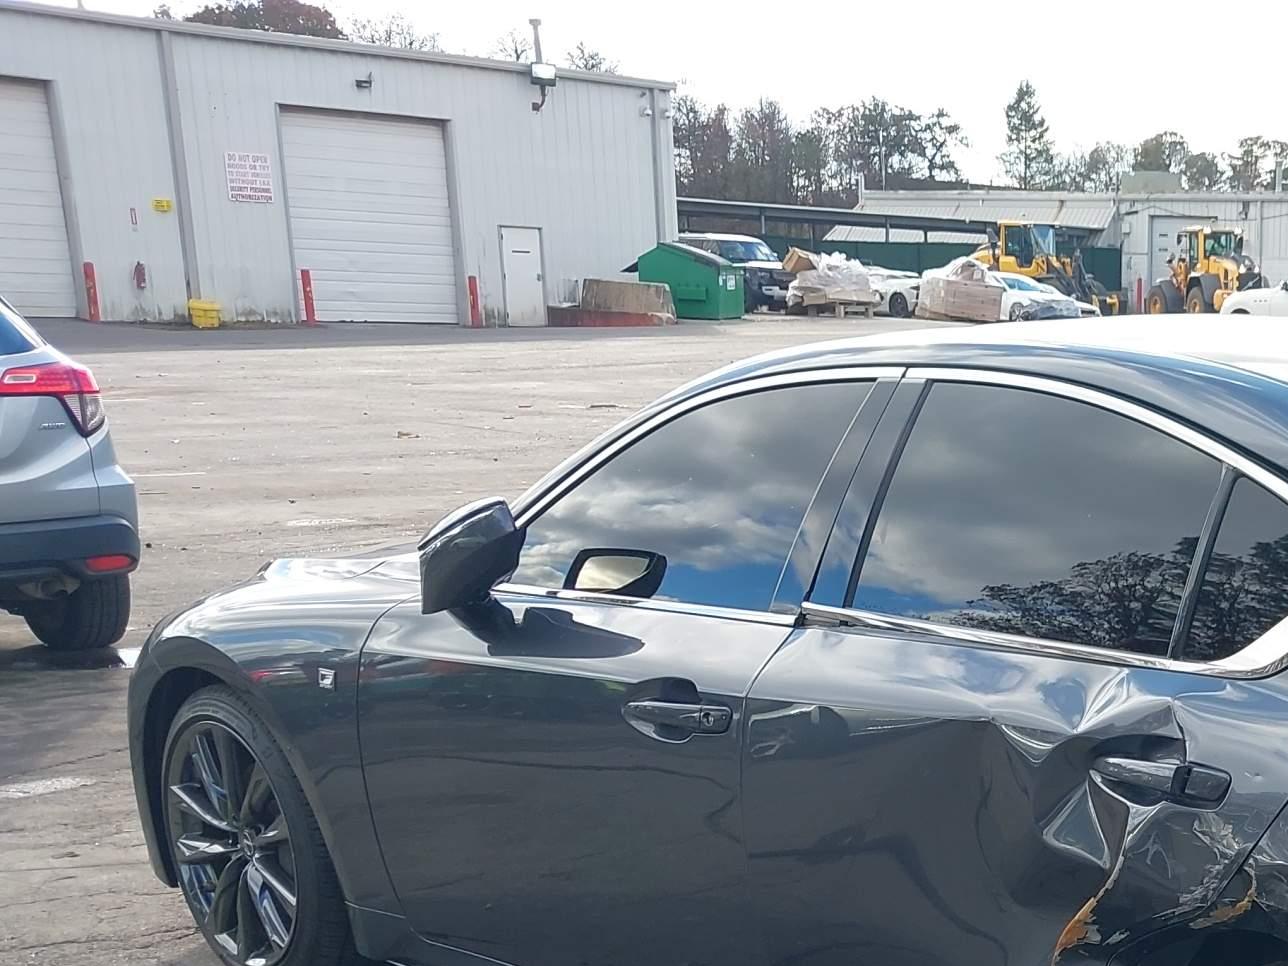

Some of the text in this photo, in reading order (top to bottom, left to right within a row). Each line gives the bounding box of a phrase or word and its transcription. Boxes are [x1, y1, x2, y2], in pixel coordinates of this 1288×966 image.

[227, 153, 268, 164] DO NOT OPEN
